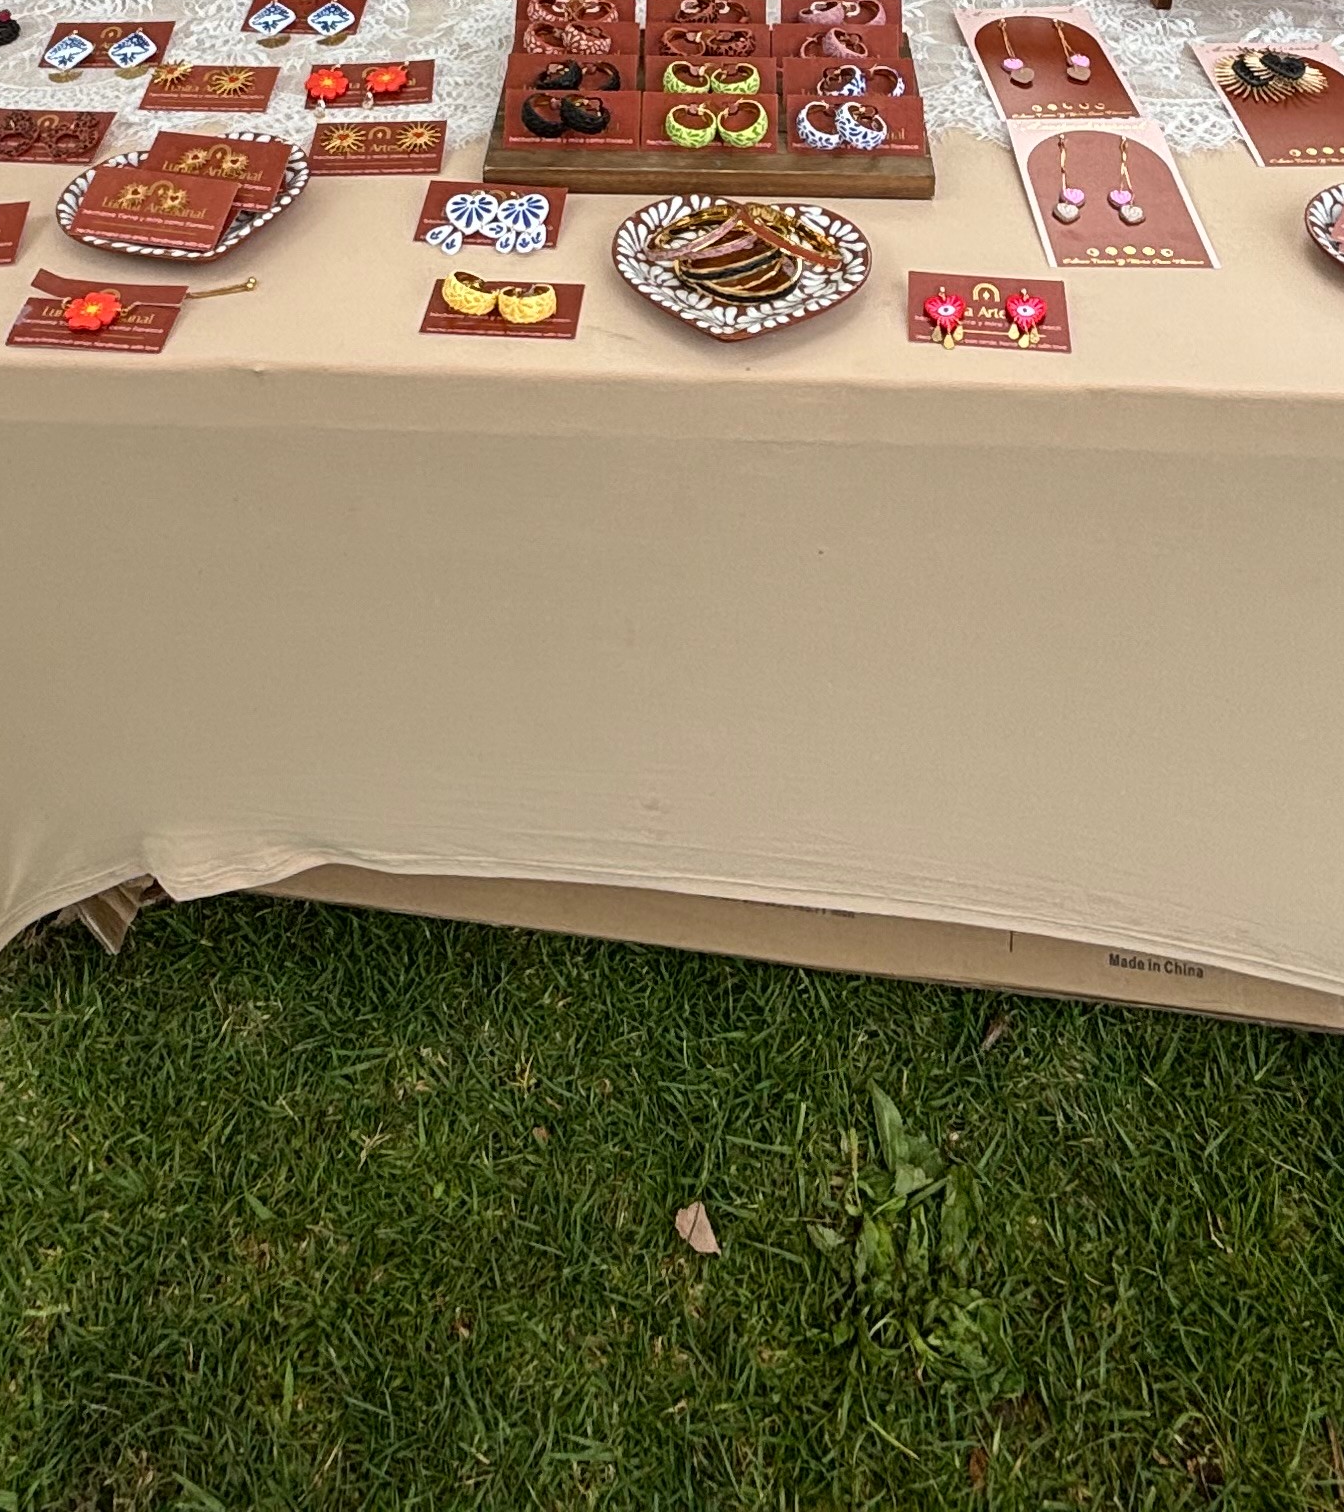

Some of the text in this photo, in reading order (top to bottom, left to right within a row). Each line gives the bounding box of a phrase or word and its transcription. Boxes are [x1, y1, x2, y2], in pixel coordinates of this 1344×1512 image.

[1109, 953, 1204, 979] Made in China
